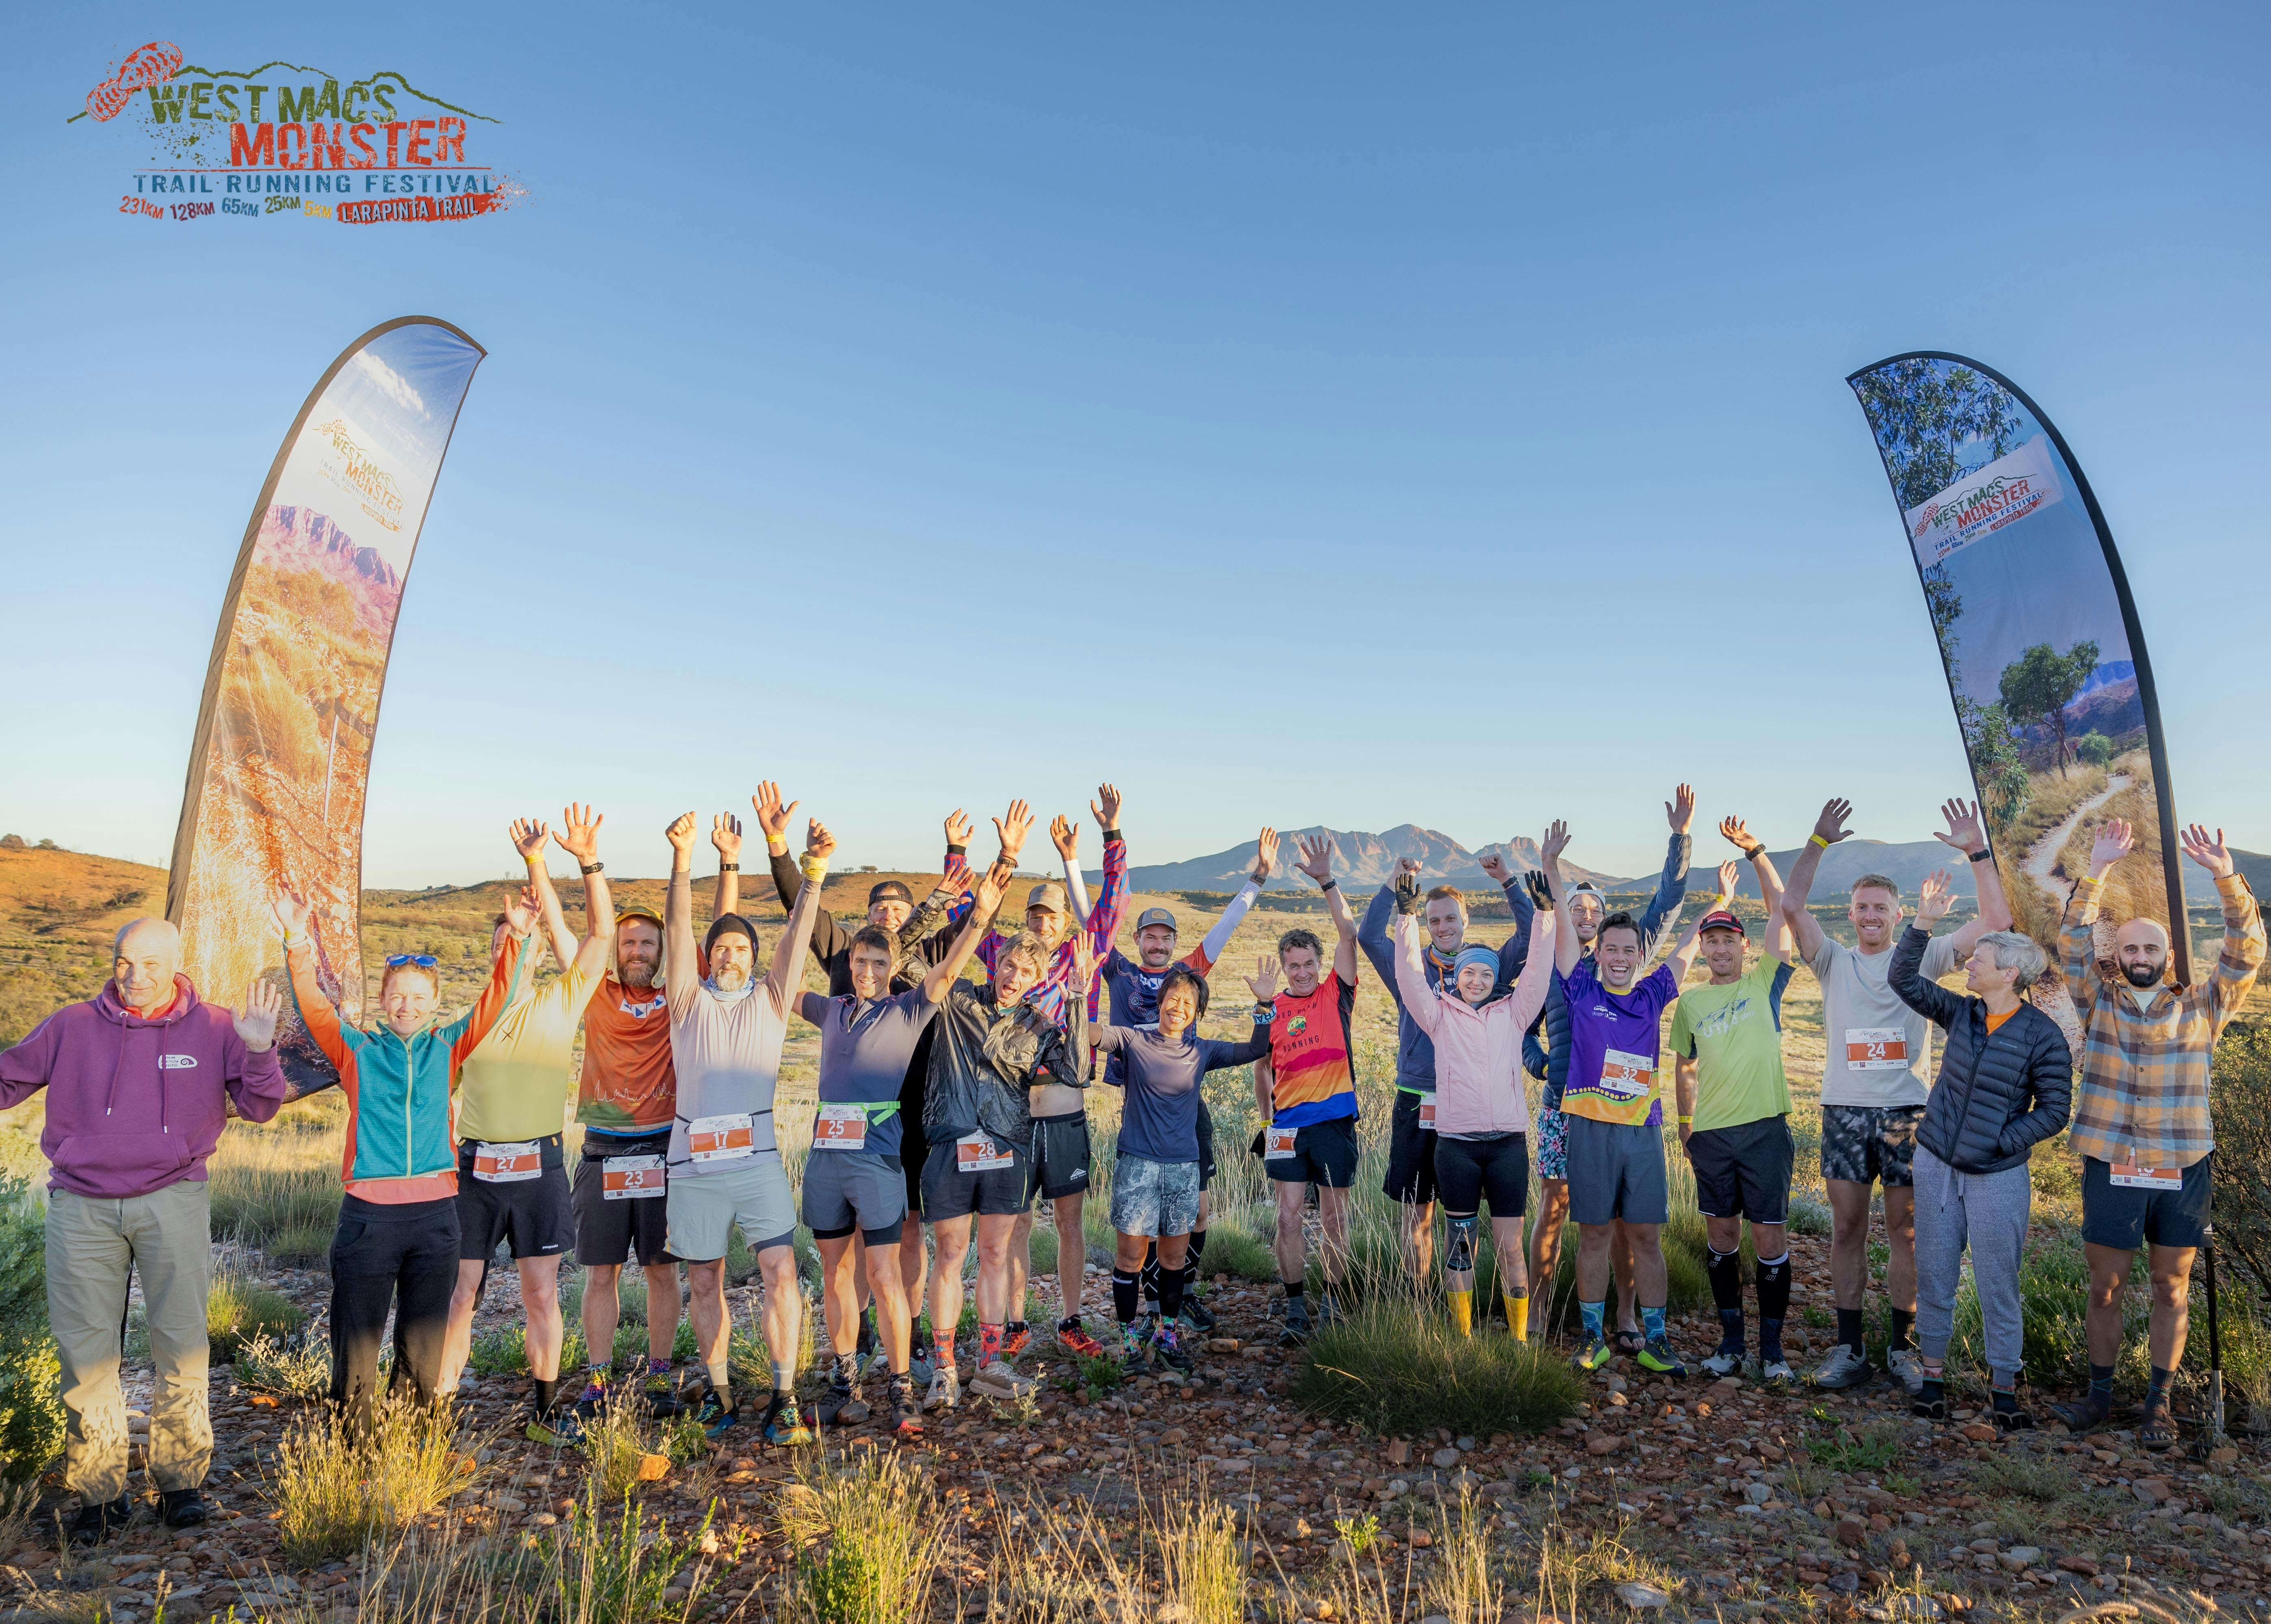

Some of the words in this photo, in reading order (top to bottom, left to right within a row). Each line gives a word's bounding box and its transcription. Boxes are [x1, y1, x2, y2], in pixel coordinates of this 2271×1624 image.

[332, 432, 362, 465] WEST
[361, 459, 391, 490] MACS
[320, 458, 338, 478] TRAIL
[341, 476, 371, 503] RUNNING
[373, 502, 406, 530] FESTIVAL
[346, 461, 403, 514] MONSTER
[1932, 500, 1964, 528] WEST
[1967, 481, 2005, 508] MACS
[1957, 479, 2030, 528] MONSTER
[1934, 536, 1957, 550] TRAIL
[1960, 514, 1997, 537] RUNNING
[2001, 492, 2042, 516] FESTIVAL
[1991, 511, 2019, 531] LARAPINTA
[2020, 504, 2034, 516] TRAIL
[1938, 546, 1951, 558] 231KM
[1952, 540, 1963, 549] 65KM
[1964, 531, 1976, 542] 25KM
[1277, 1010, 1291, 1020] RED
[1283, 1035, 1319, 1053] RUNNING
[1867, 1043, 1886, 1057] 24
[1621, 1066, 1638, 1081] 32
[828, 1120, 844, 1135] 25
[713, 1130, 729, 1147] 17
[1268, 1136, 1280, 1149] 20
[978, 1142, 996, 1157] 28
[497, 1156, 516, 1169] 27
[625, 1170, 643, 1186] 23
